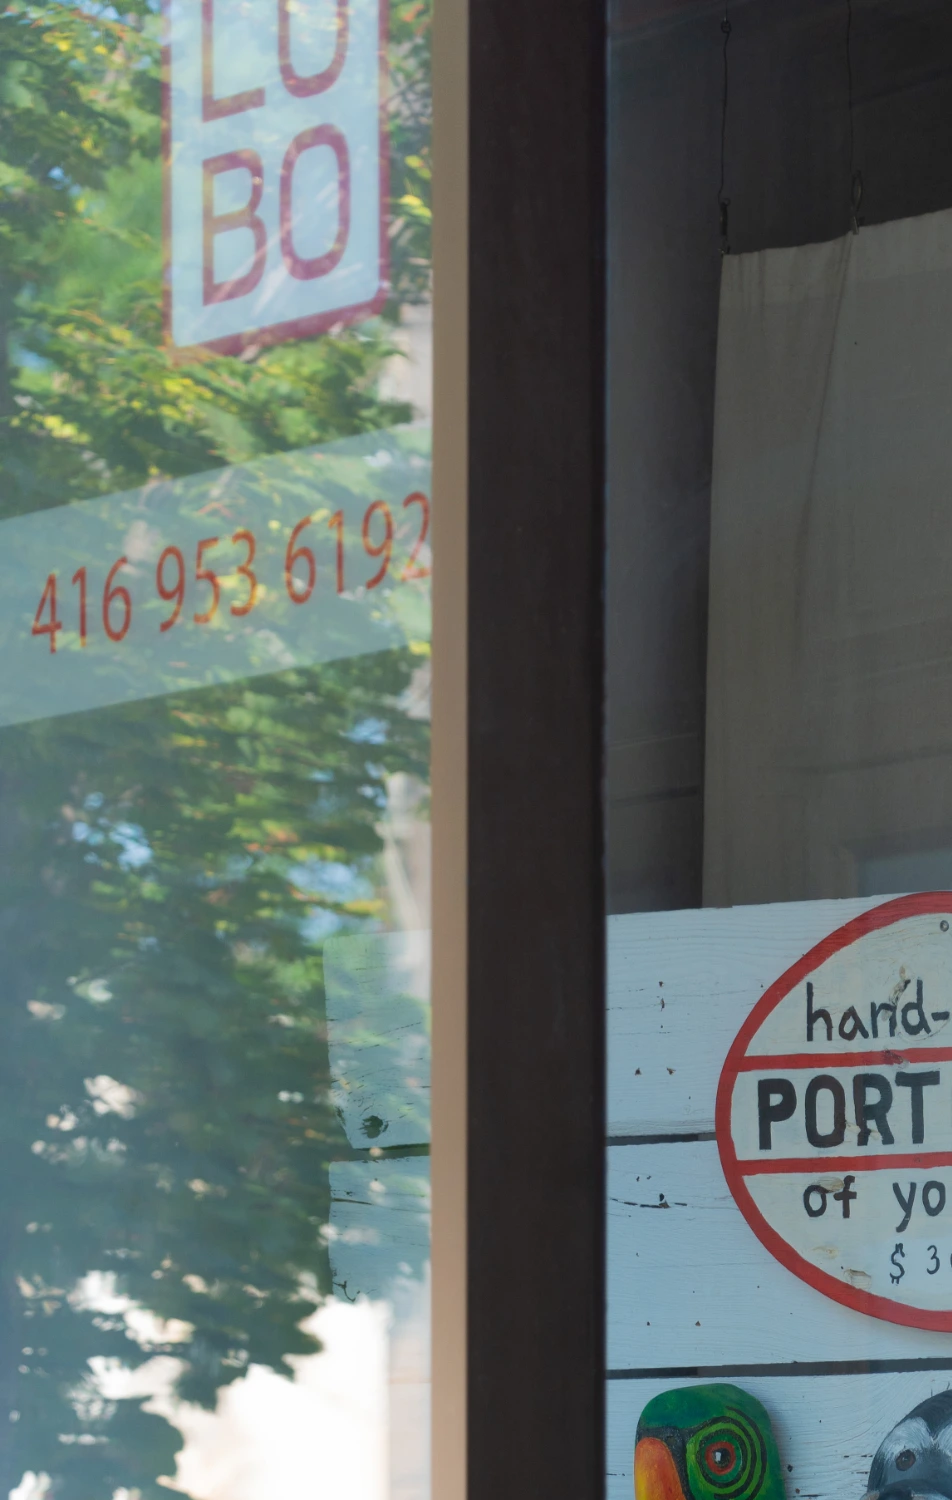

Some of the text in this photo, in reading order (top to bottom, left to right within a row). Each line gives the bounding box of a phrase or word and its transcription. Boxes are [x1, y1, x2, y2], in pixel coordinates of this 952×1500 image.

[202, 123, 350, 307] BO
[31, 491, 431, 655] 416 953 6192
[803, 1175, 857, 1219] of
